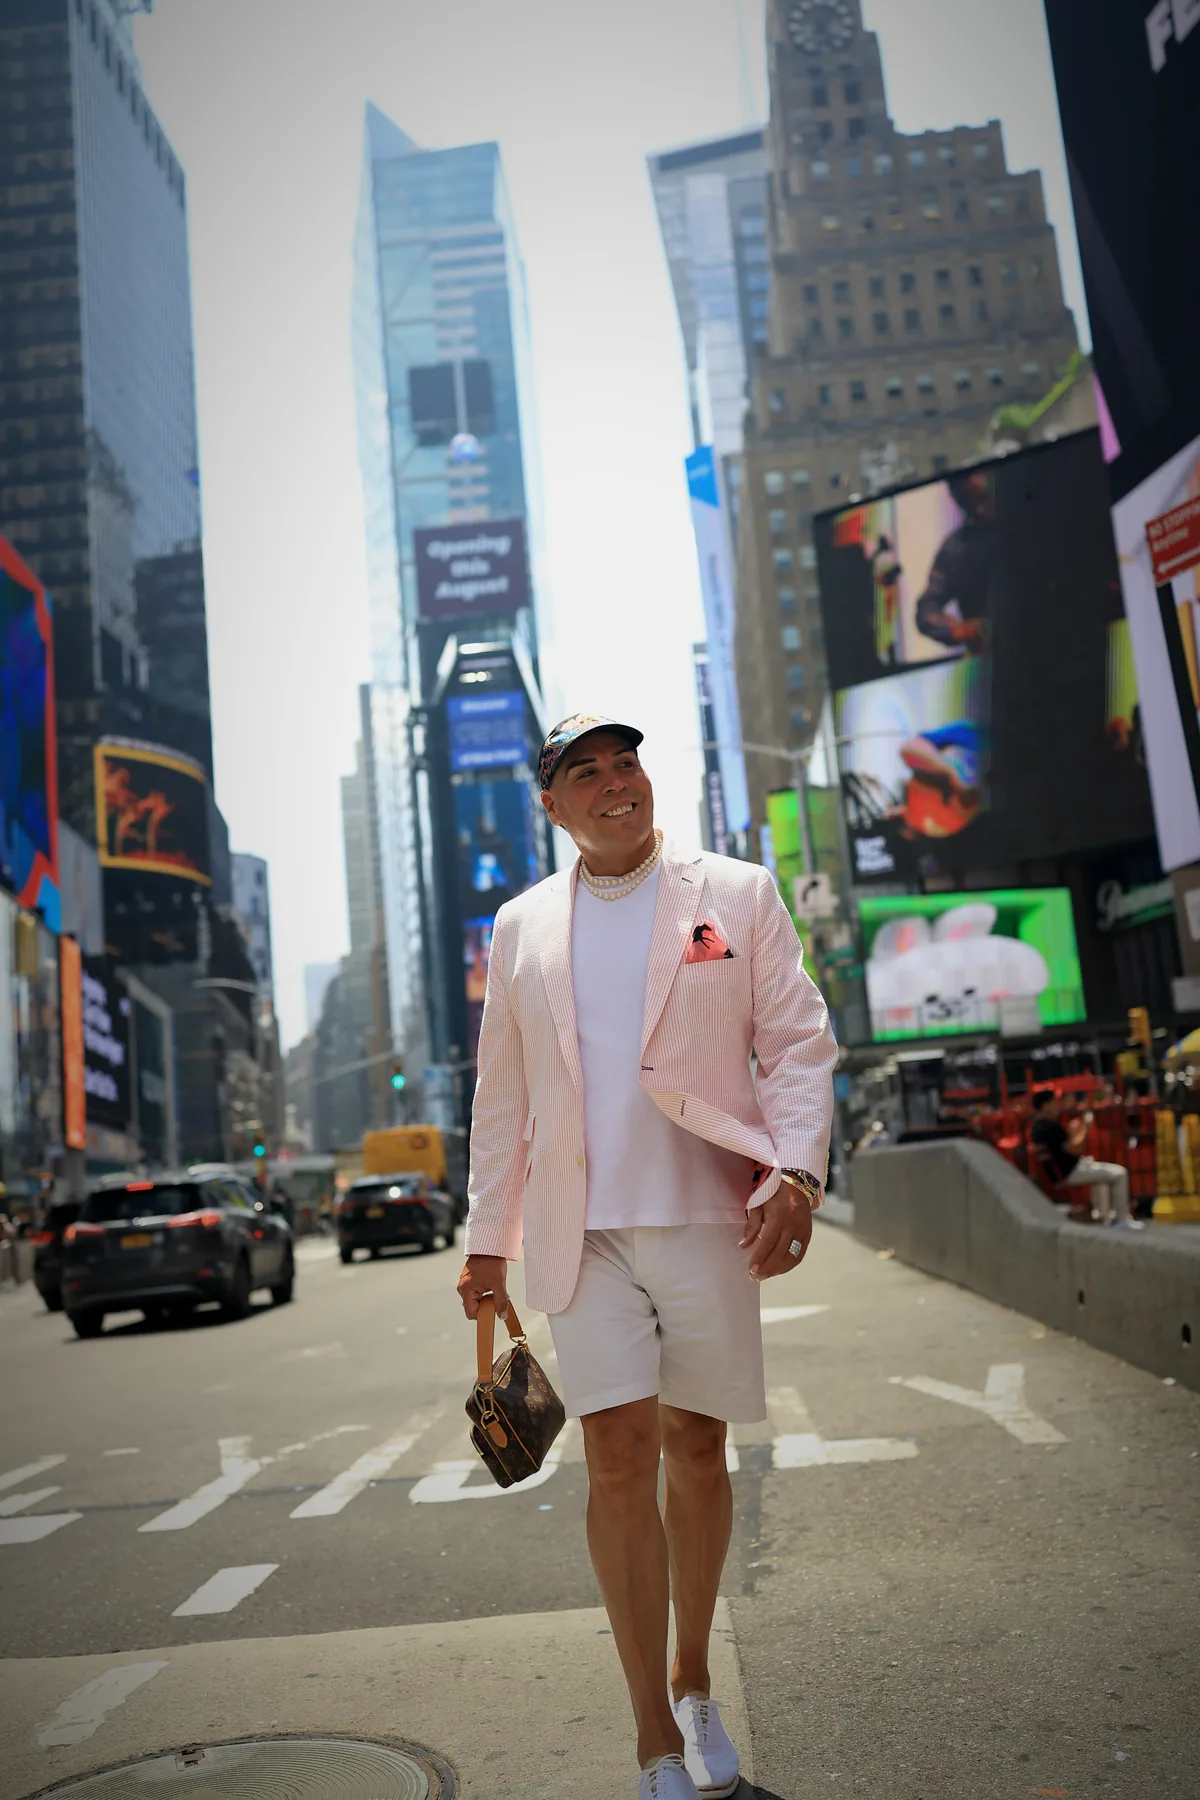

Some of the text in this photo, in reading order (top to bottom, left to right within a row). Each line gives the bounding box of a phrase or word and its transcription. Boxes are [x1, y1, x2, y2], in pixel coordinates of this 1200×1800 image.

[426, 533, 512, 563] Opening
[1151, 526, 1189, 552] Anytime
[450, 557, 491, 578] this
[434, 575, 511, 602] August
